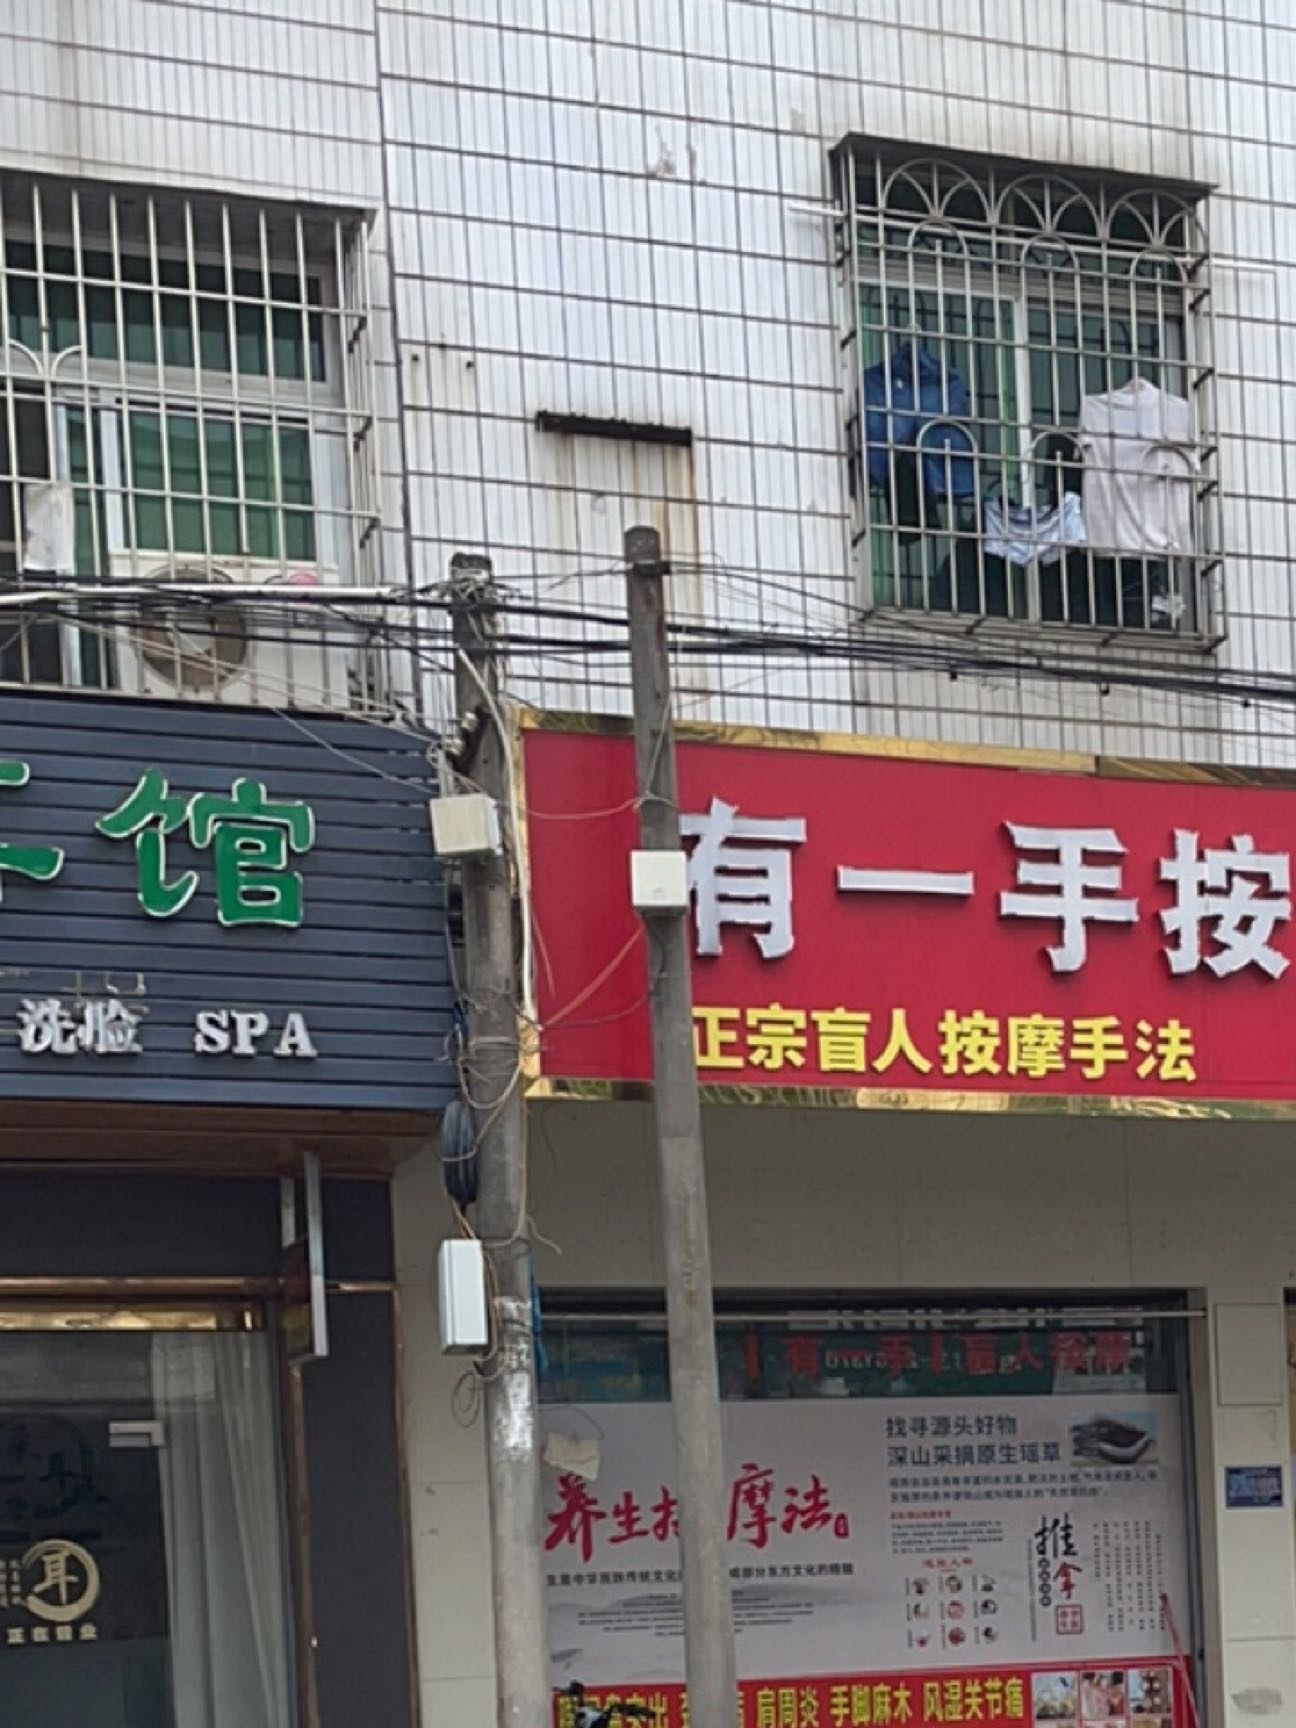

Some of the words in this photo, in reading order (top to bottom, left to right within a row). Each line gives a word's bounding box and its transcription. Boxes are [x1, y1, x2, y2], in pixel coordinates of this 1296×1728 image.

[195, 1009, 317, 1058] SPA
[692, 1004, 1197, 1082] 正宗盲人按摩手法
[830, 1682, 912, 1728] 手脚麻木
[923, 1676, 1024, 1722] 风湿关节痛
